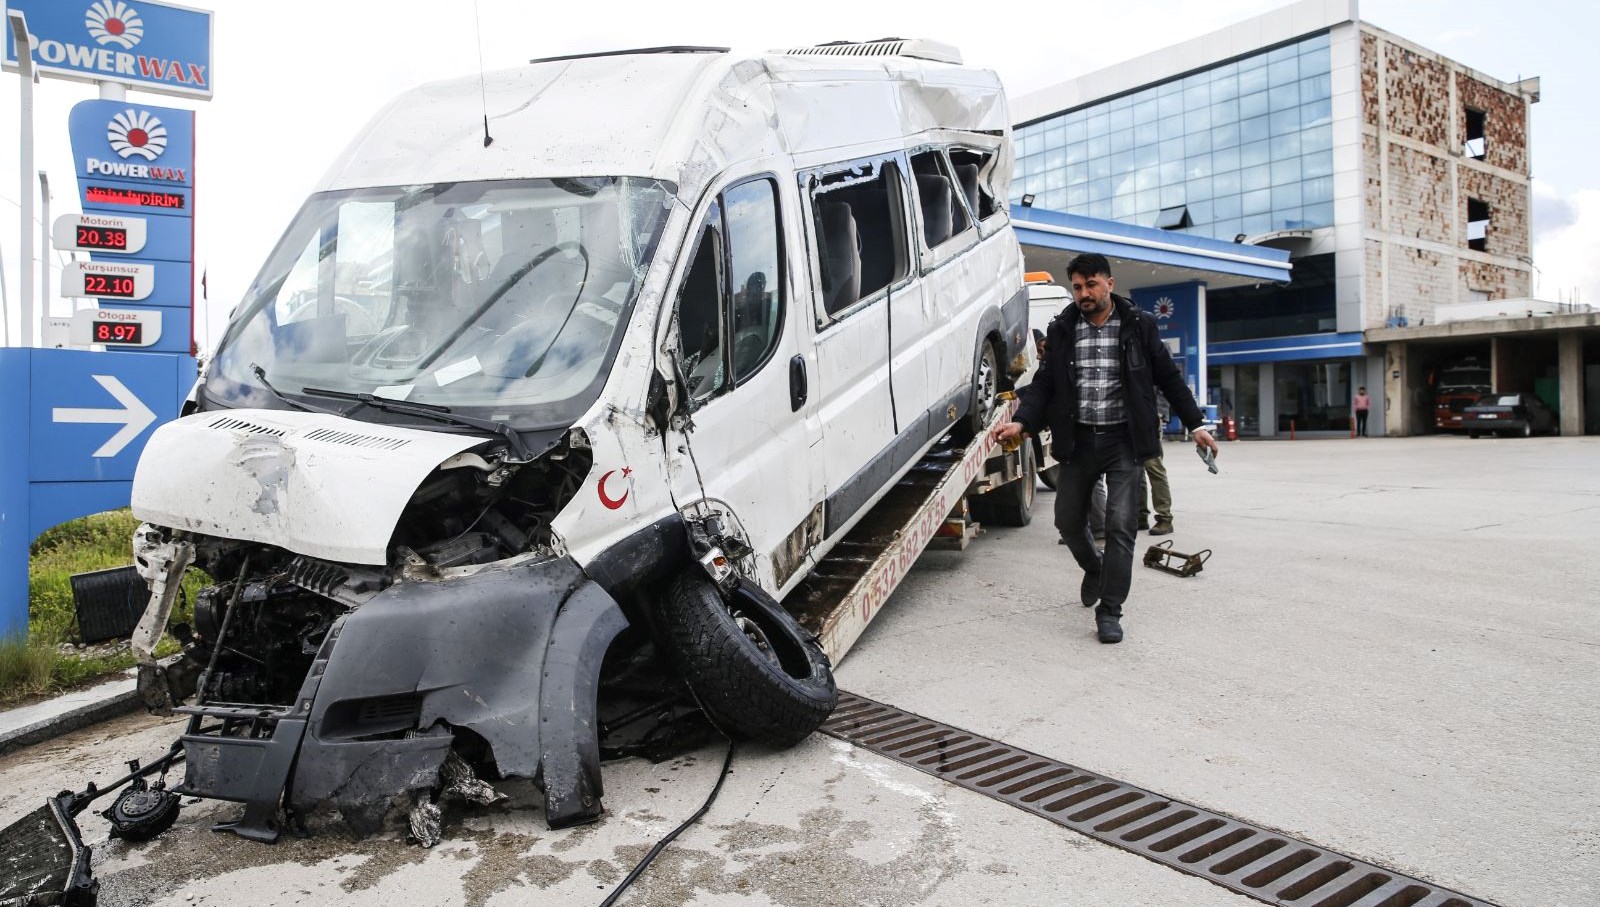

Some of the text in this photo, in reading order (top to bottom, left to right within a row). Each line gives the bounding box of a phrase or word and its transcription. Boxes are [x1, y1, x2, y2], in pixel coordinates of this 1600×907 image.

[80, 216, 124, 227] Motorin
[78, 230, 125, 247] 20.38
[79, 262, 139, 275] Kurşunsuz
[85, 277, 134, 293] 22.10
[98, 311, 137, 322] Otogaz
[98, 325, 136, 340] 8.97
